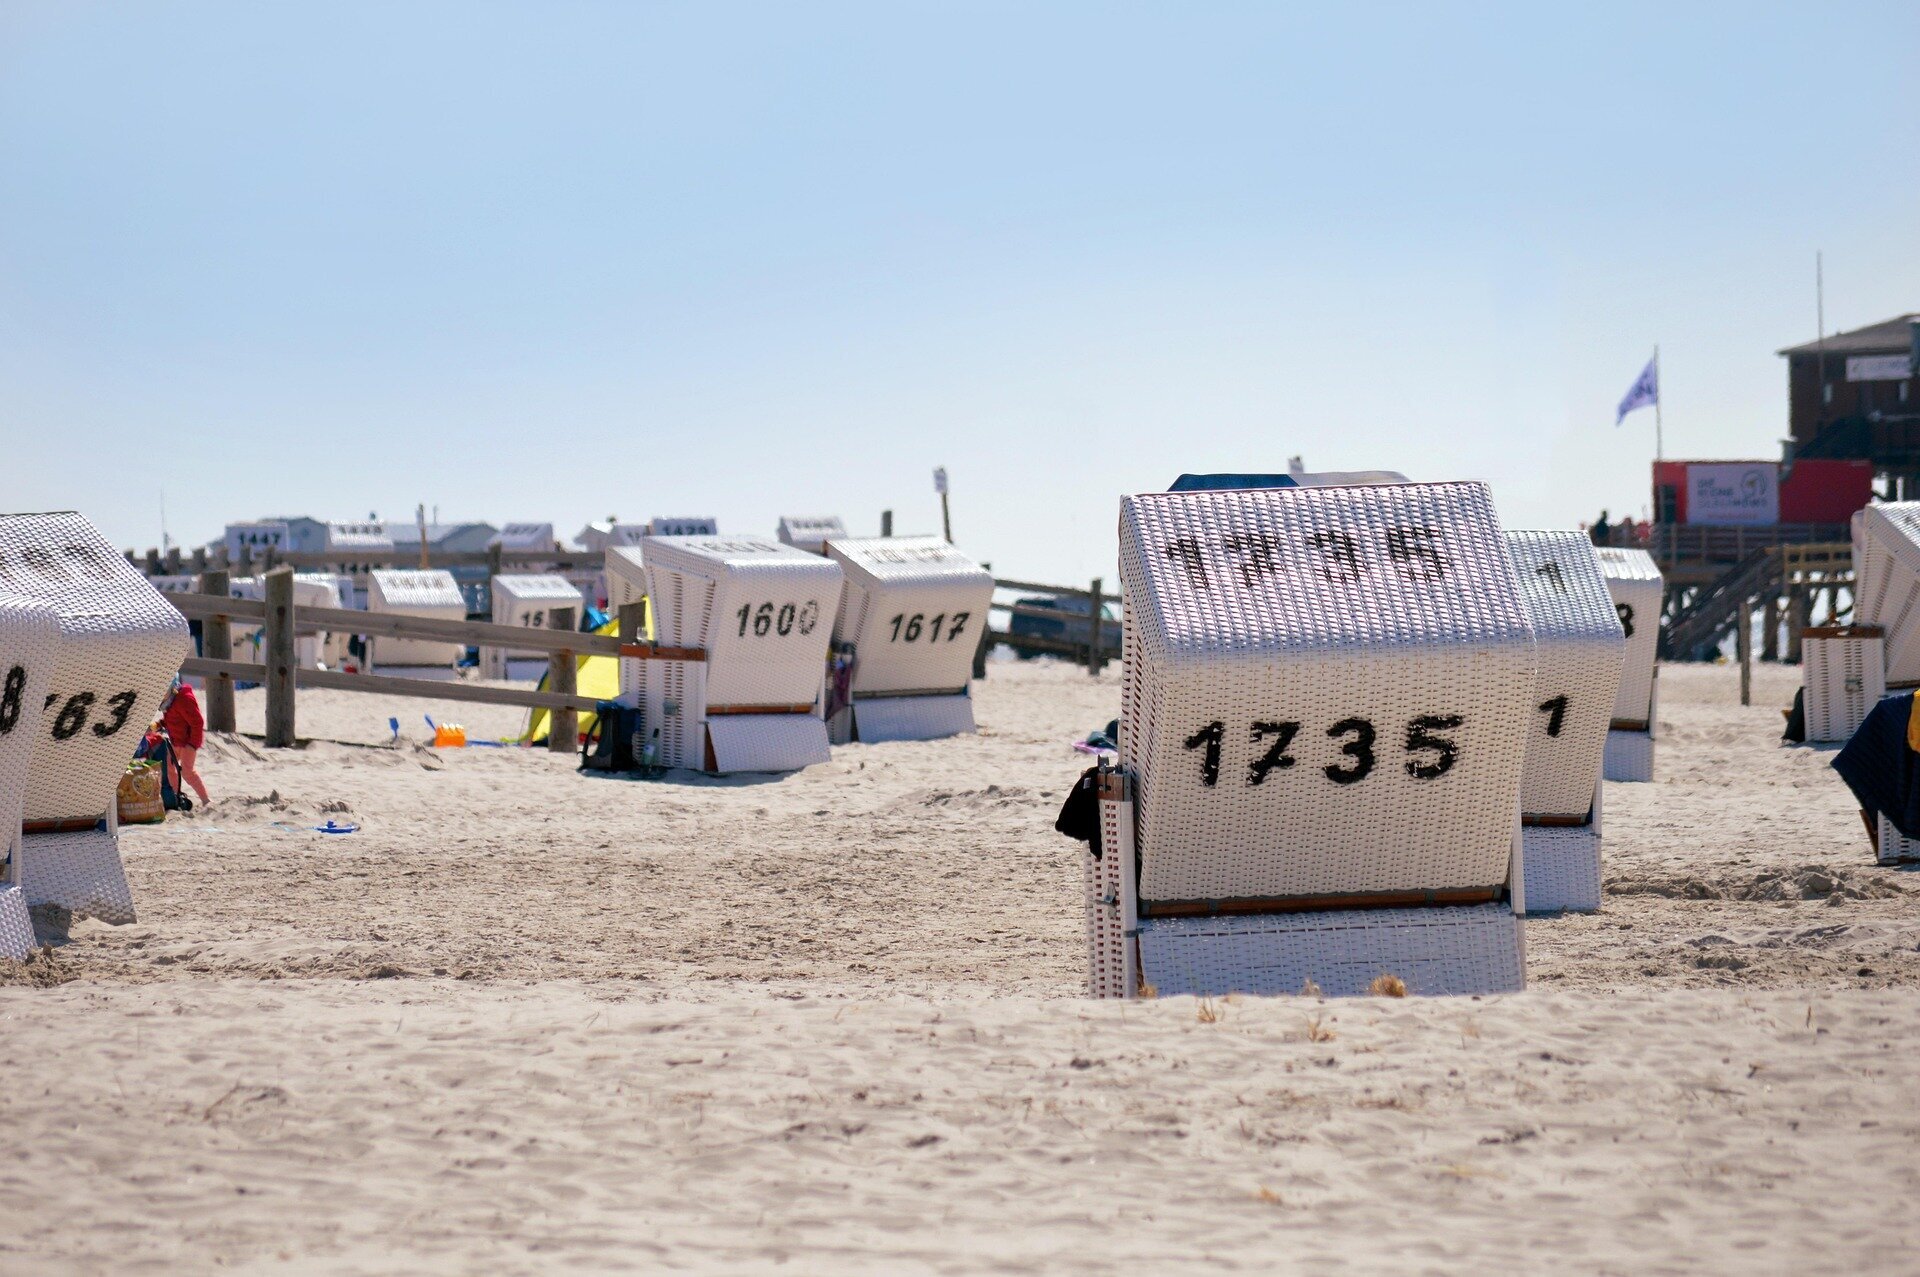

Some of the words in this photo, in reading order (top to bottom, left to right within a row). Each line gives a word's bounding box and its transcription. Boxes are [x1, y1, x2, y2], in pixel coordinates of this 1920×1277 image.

[1167, 526, 1451, 588] 1735
[737, 600, 818, 637] 1600
[890, 612, 969, 642] 1617
[43, 689, 137, 740] 63
[1183, 714, 1465, 787] 1735
